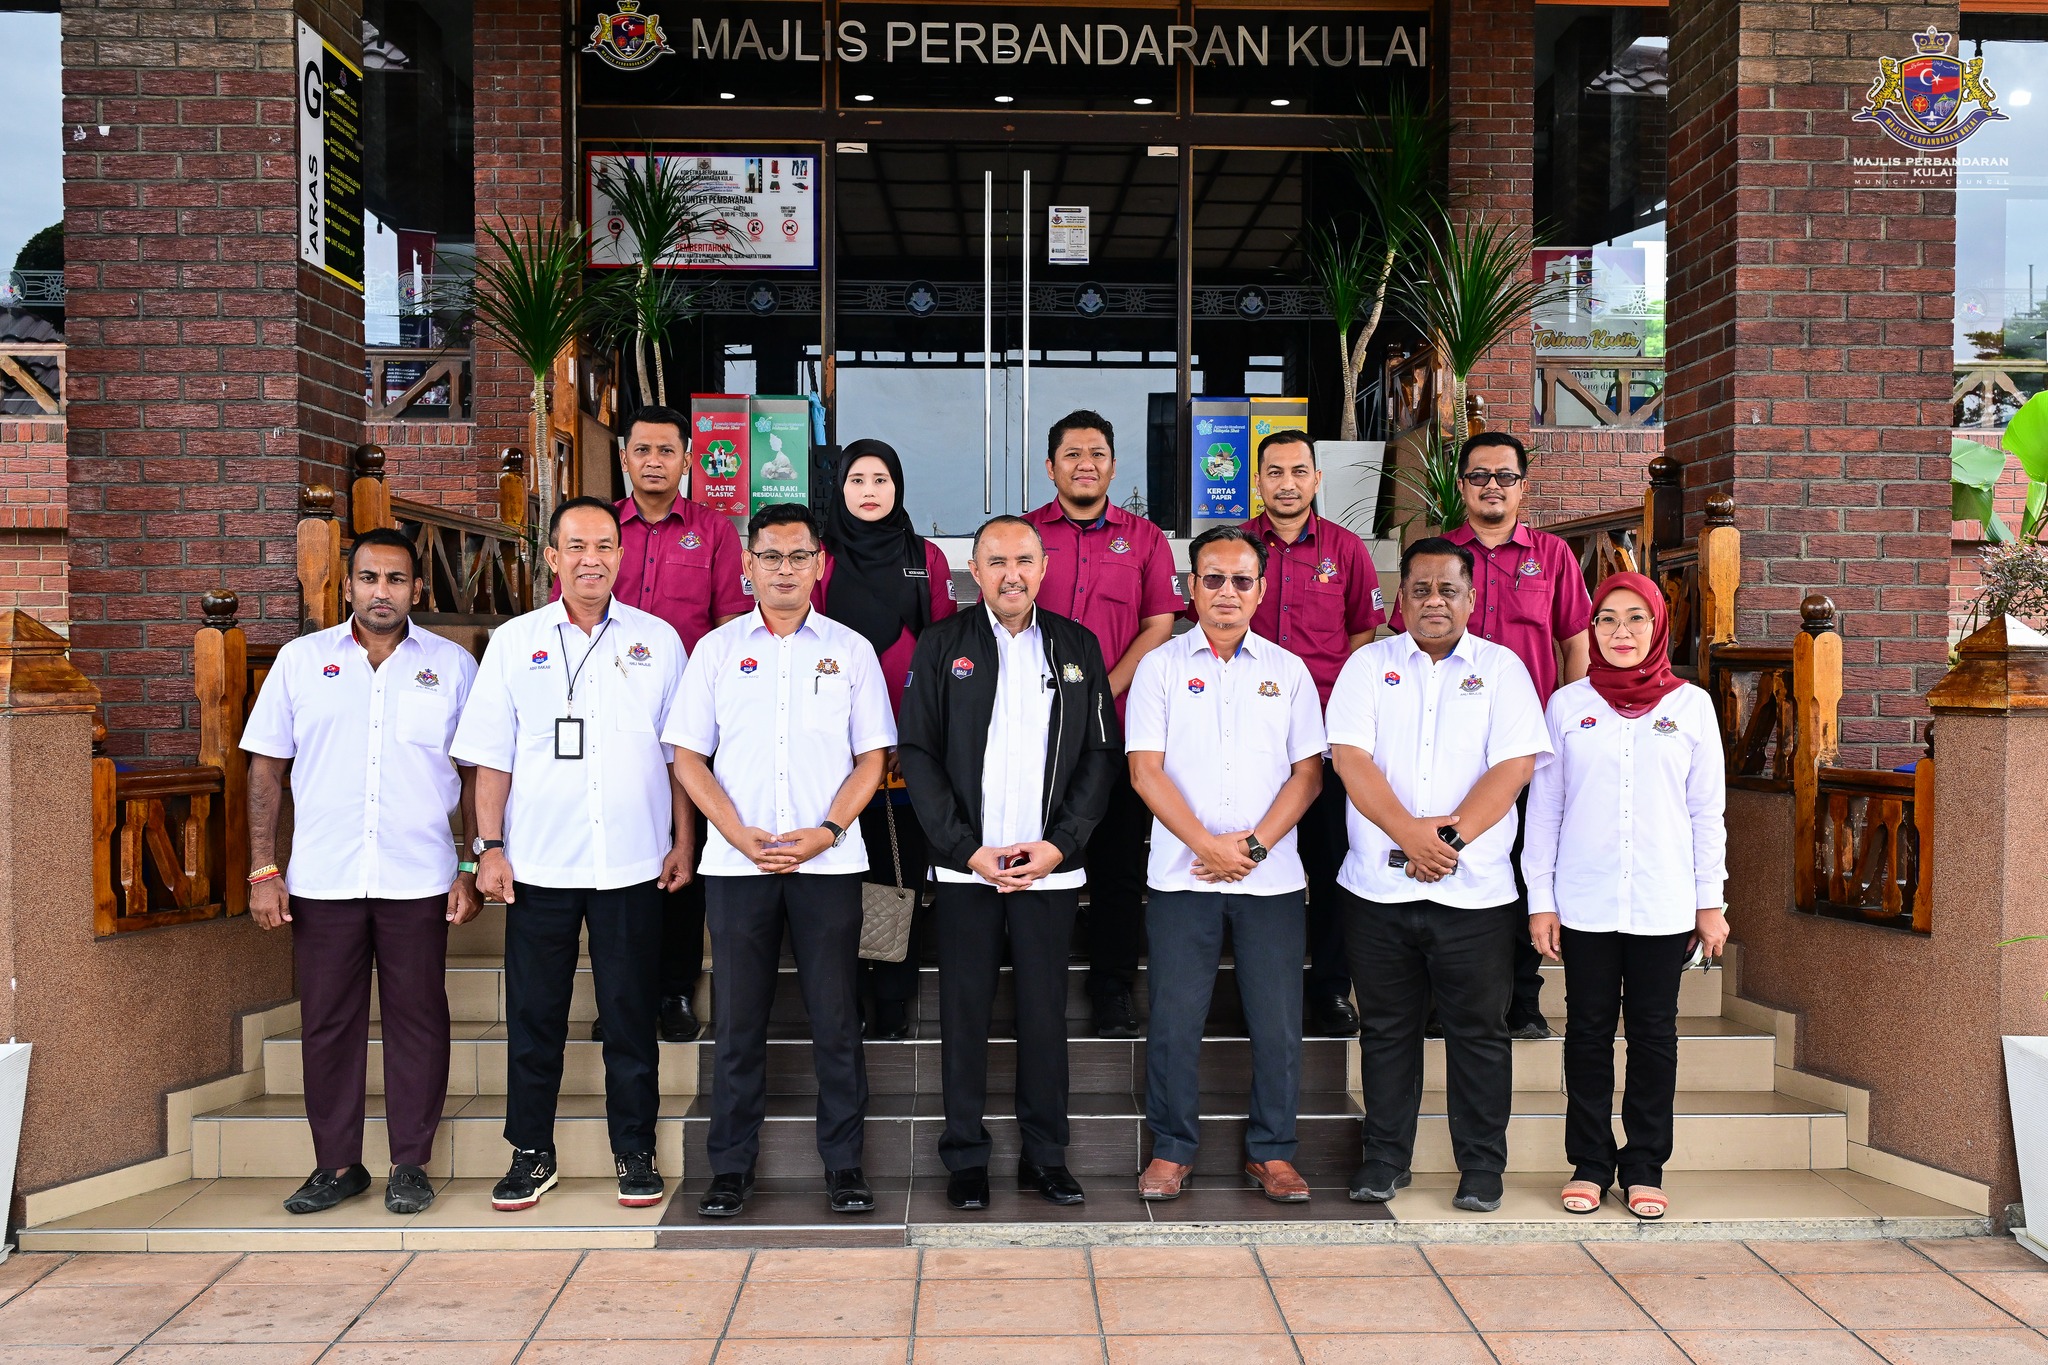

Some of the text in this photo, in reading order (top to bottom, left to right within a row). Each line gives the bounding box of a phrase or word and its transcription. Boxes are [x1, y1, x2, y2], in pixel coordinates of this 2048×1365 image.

[692, 18, 1426, 67] MAJLIS PERBANDARAN KULAI
[304, 60, 322, 255] ARAS G
[679, 195, 753, 205] AUNTER PEMBAYARAN
[675, 243, 731, 252] PEMBERITAHUAN
[1533, 328, 1641, 349] Terima Kasih
